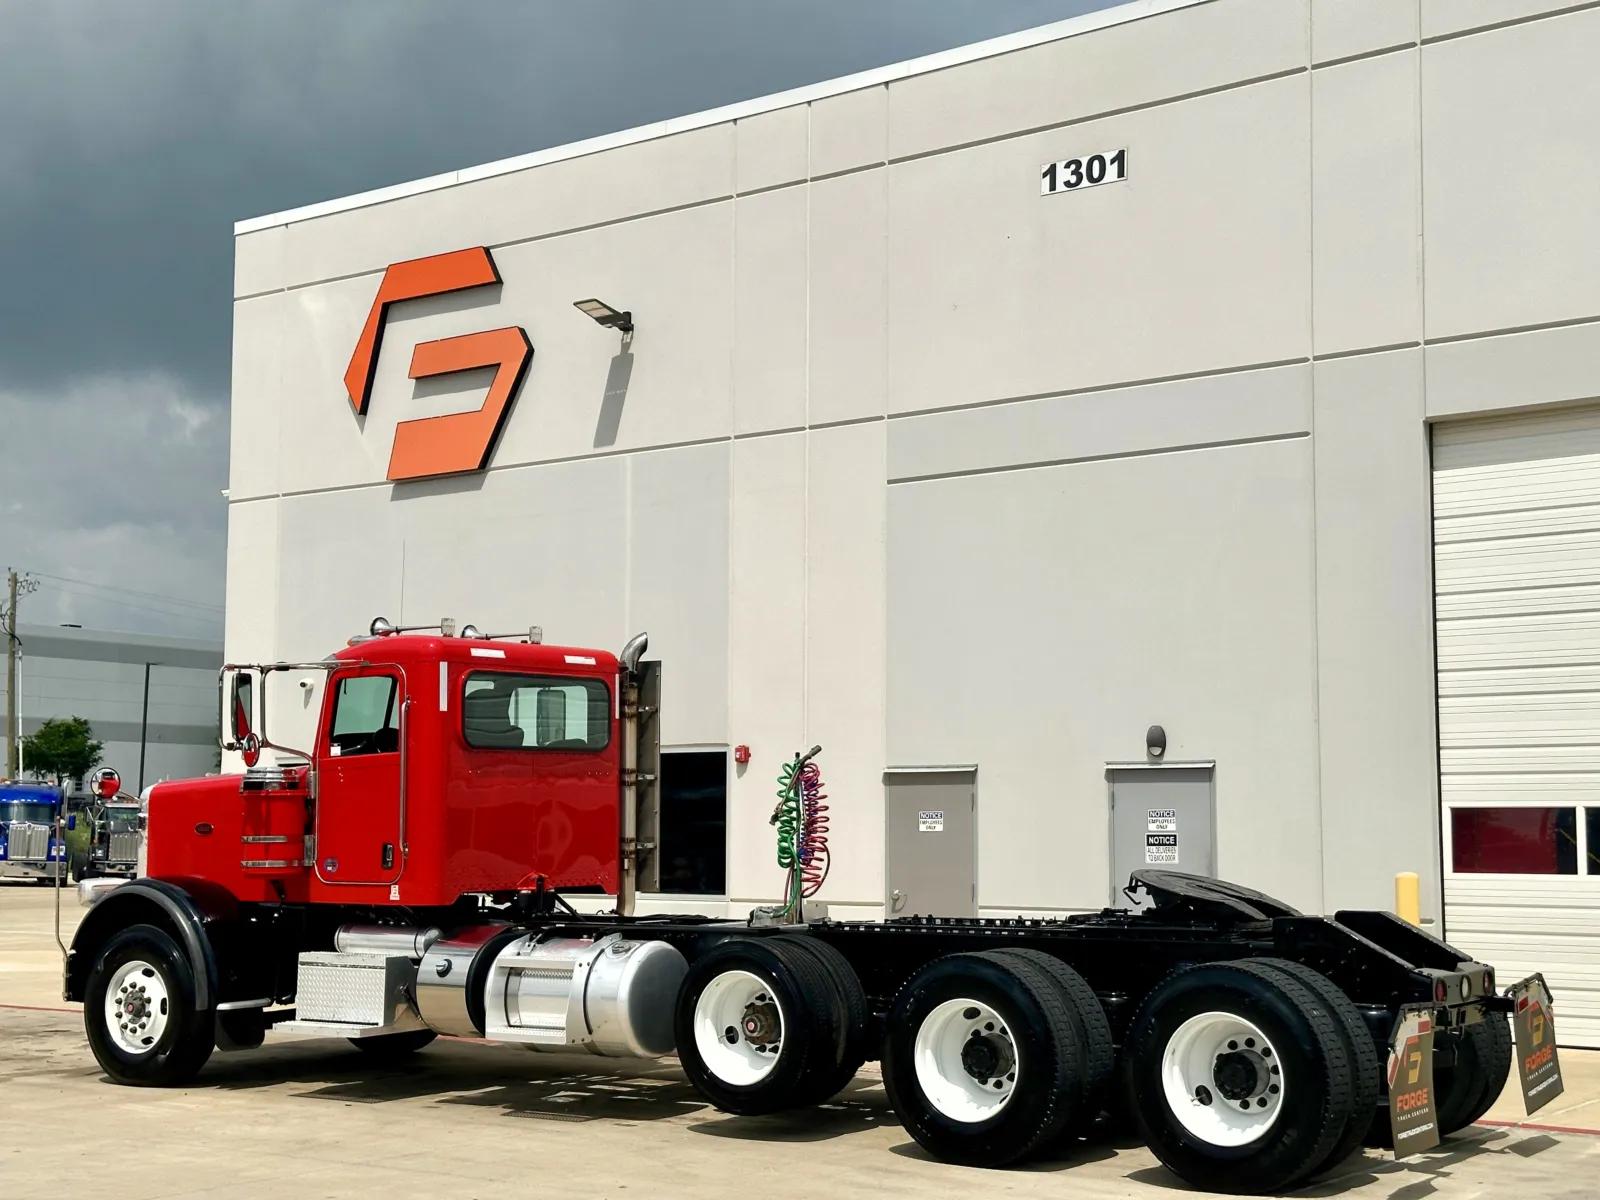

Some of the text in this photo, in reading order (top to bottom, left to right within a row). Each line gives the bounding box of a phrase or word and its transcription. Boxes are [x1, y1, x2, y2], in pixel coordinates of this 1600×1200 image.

[1042, 149, 1125, 192] 1301
[1149, 810, 1175, 818] NOTICE
[1148, 836, 1175, 844] NOTICE
[1525, 1043, 1553, 1073] FORGE
[1396, 1088, 1429, 1112] FORGE
